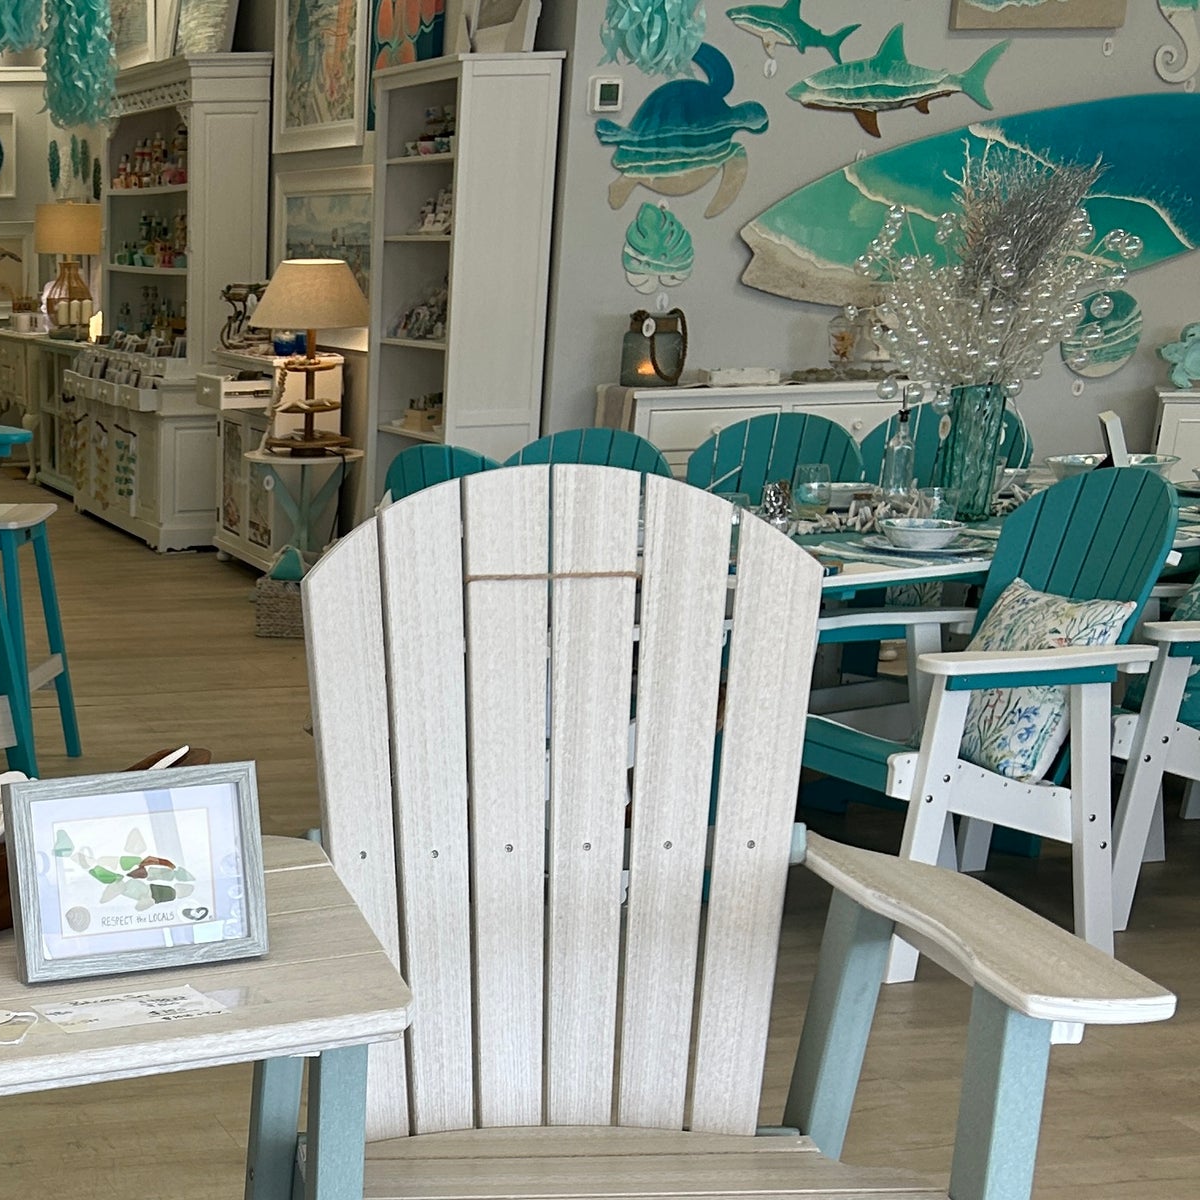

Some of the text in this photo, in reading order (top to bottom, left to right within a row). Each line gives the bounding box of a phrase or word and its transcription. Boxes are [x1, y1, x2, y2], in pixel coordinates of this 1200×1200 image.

[101, 912, 175, 927] RESPECT the LOCALS
